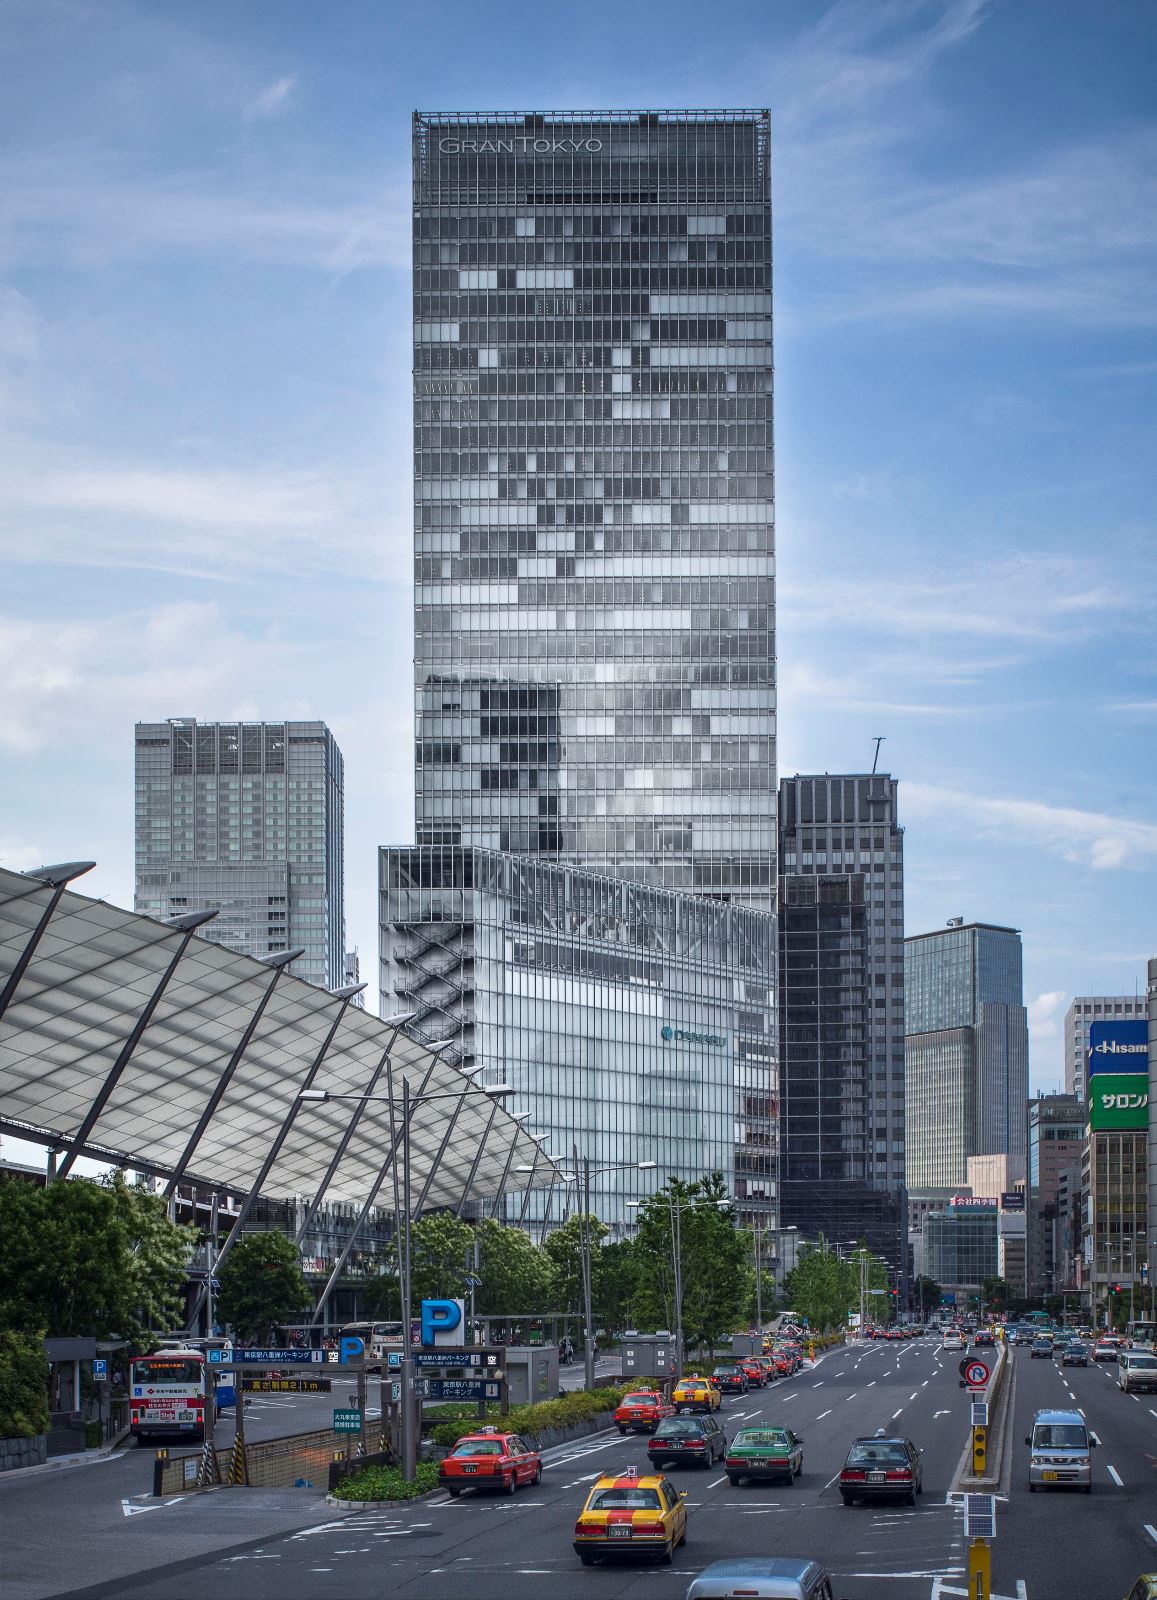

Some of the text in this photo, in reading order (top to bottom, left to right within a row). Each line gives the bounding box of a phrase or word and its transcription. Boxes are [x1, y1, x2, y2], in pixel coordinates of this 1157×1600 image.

[421, 1299, 462, 1346] P
[221, 1352, 228, 1361] P
[341, 1336, 364, 1366] P
[96, 1361, 104, 1372] P
